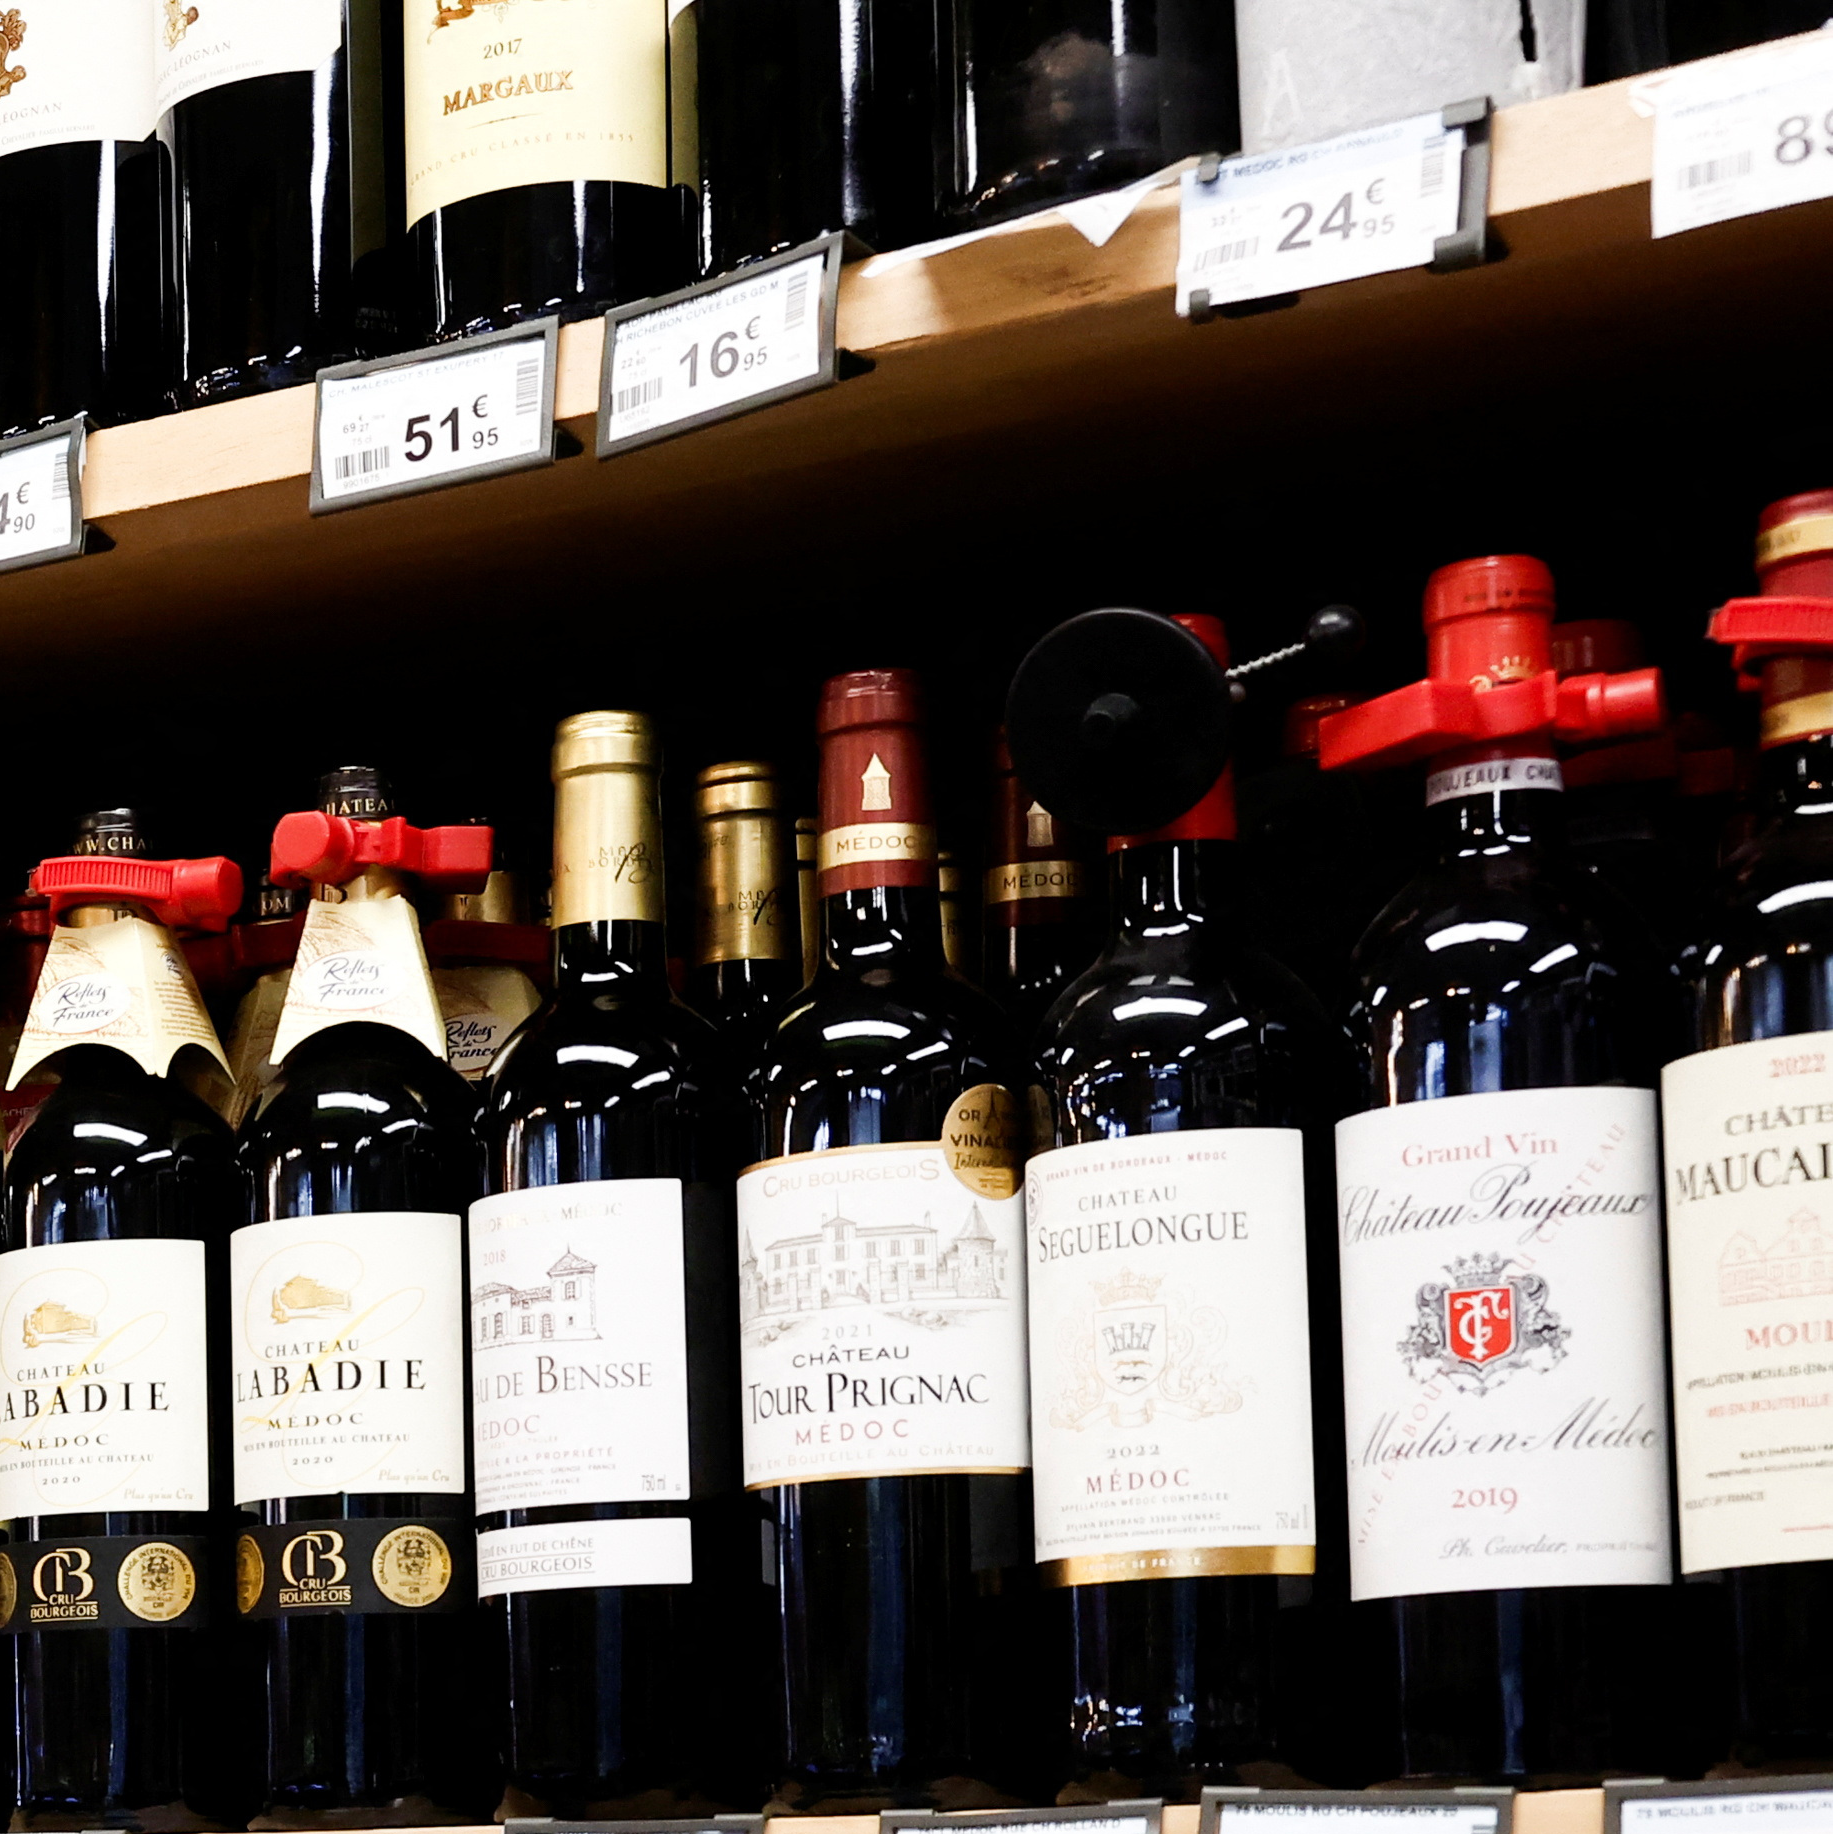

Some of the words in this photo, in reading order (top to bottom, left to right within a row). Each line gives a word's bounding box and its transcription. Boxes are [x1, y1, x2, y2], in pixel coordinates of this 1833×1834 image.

[484, 38, 522, 59] 2017
[443, 69, 574, 116] MARGAUX
[1769, 1053, 1826, 1076] 2022
[1402, 1136, 1492, 1167] Grand
[1506, 1135, 1557, 1157] Vin
[1341, 1185, 1477, 1244] Château
[1470, 1162, 1651, 1244] Poujeaux
[1038, 1210, 1249, 1263] SEGUELONGUE
[792, 1345, 909, 1368] CHÂTEAU
[237, 1359, 426, 1403] LABADIE
[498, 1373, 524, 1397] DE
[536, 1355, 652, 1393] BENSSE
[795, 1419, 909, 1446] MÉDOC
[1086, 1469, 1191, 1494] MÉDOC
[1452, 1488, 1518, 1510] 2019
[280, 1588, 351, 1602] BOURGEOIS
[31, 1604, 99, 1619] BOURGEOIS
